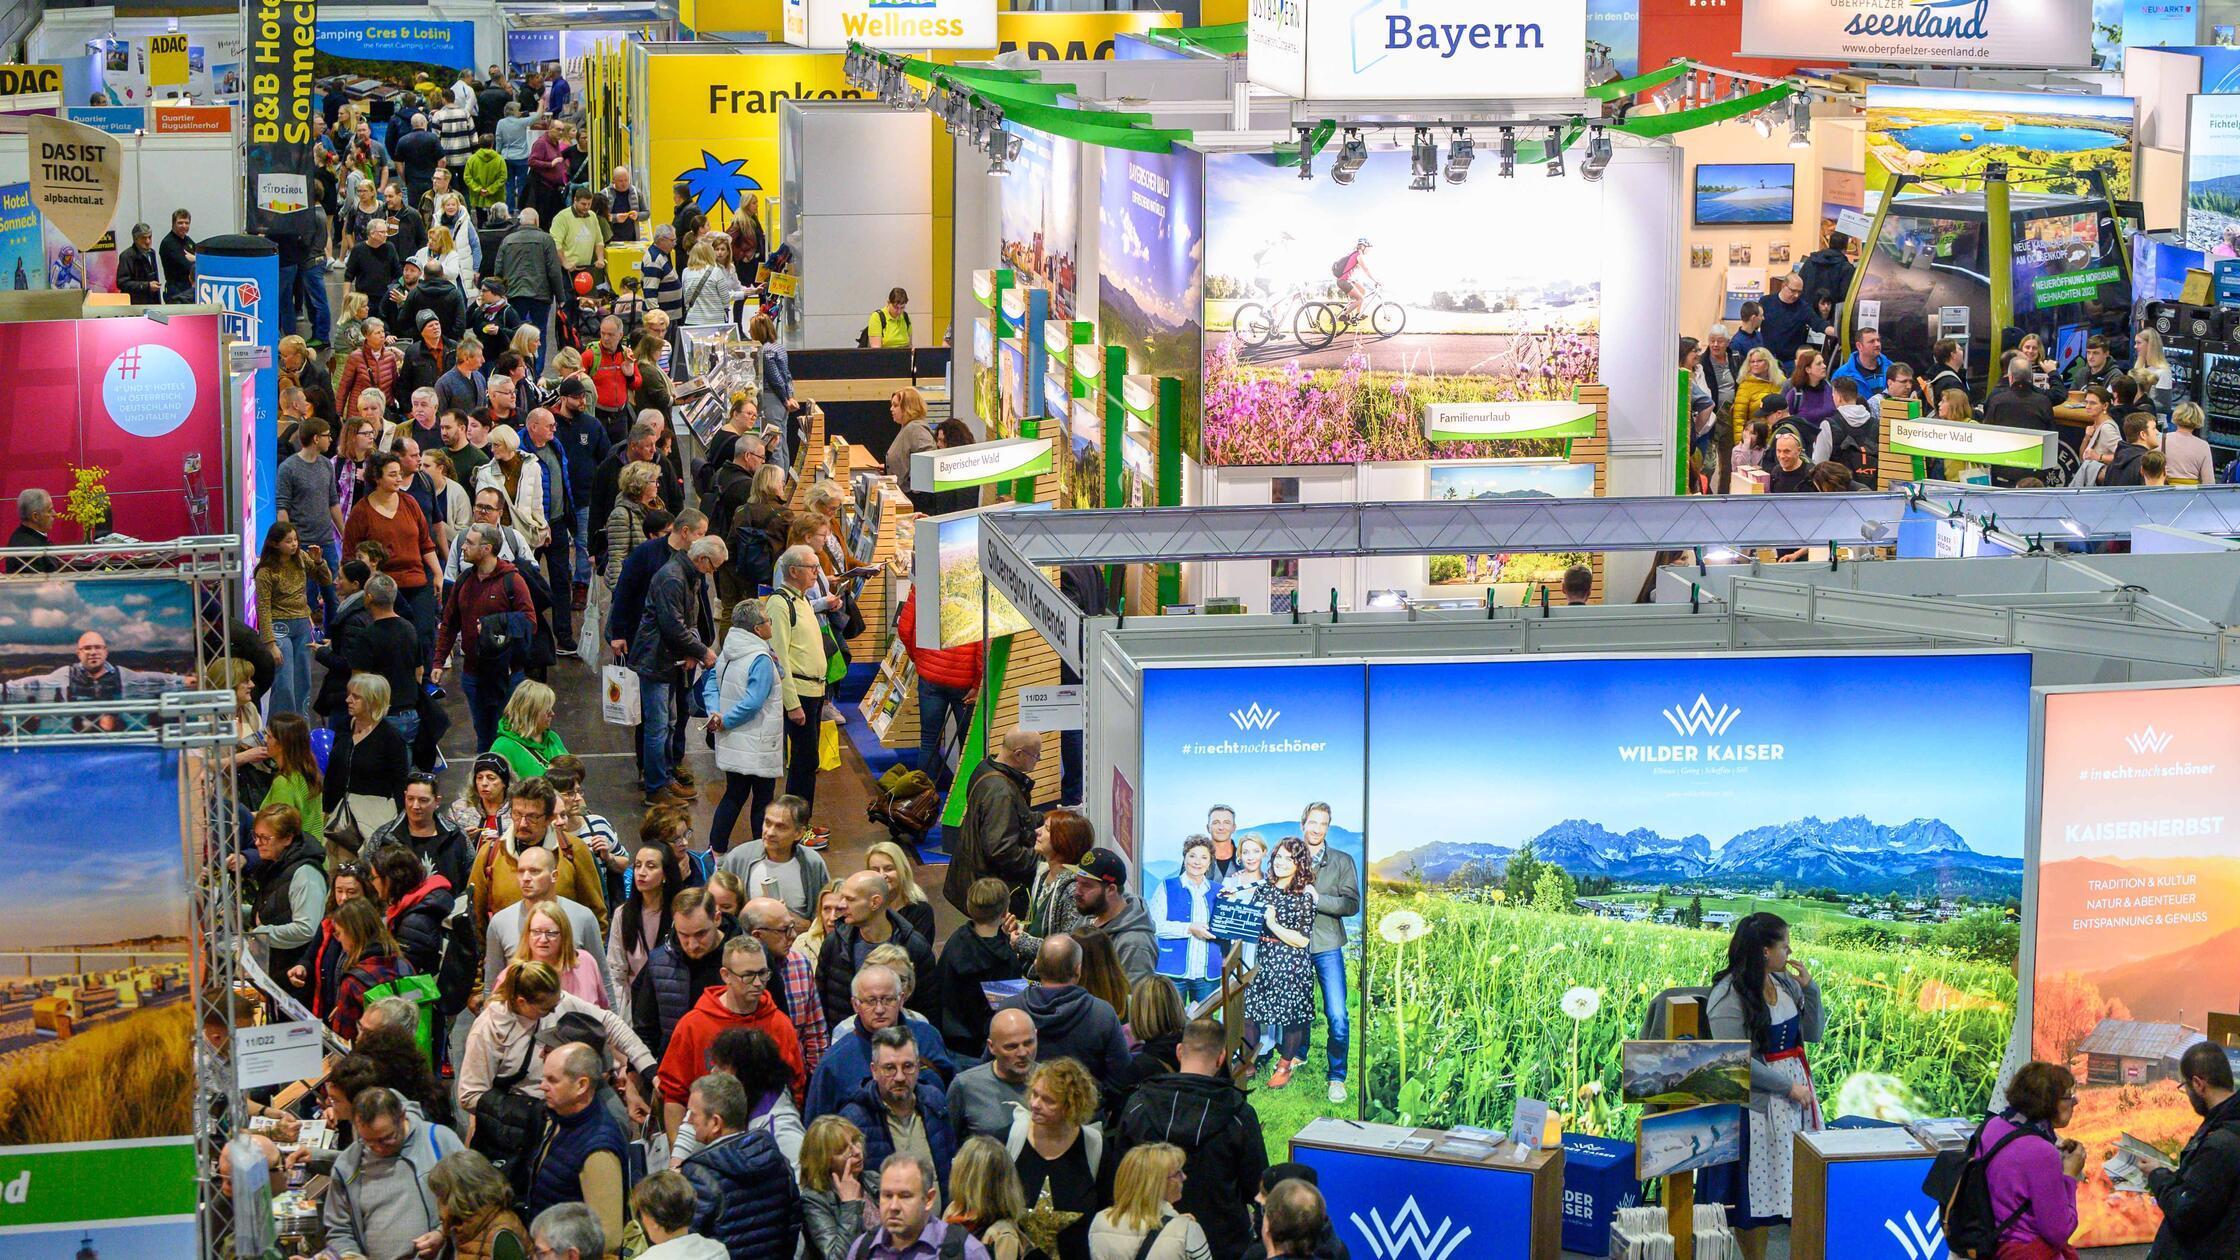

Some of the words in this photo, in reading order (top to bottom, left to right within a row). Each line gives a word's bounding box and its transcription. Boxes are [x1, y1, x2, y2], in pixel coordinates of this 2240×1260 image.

[842, 13, 964, 37] Wellness
[1605, 12, 1622, 21] den
[1844, 0, 1988, 39] seenland
[316, 29, 363, 42] Camping
[366, 27, 397, 38] Cres
[401, 27, 410, 38] &
[414, 27, 451, 42] Lošinj
[1385, 15, 1544, 58] Bayern
[152, 37, 187, 54] ADAC
[1842, 44, 1990, 58] www.oberpfaelzer-seenland.de
[284, 0, 315, 145] Sonnec
[254, 73, 279, 143] B&B
[162, 122, 220, 131] Augustinerhof
[42, 143, 77, 161] DAS
[80, 146, 106, 162] IST
[41, 164, 99, 184] TIROL.
[3, 191, 30, 210] Hotel
[43, 193, 104, 206] alpbachtal.at
[0, 210, 37, 232] Sonneck
[2013, 241, 2031, 253] NEUE
[2016, 255, 2026, 265] AM
[2035, 275, 2085, 290] NEUERÖFFNUNG
[2085, 270, 2119, 284] NORDBAHN
[200, 283, 235, 311] SKI
[2037, 289, 2081, 303] WEIHNACHTEN
[2082, 287, 2096, 298] 2023
[153, 382, 185, 391] HOTELS
[119, 402, 181, 412] DEUTSCHLAND
[146, 413, 177, 421] ITALIEN
[1440, 412, 1510, 423] Familienurlaub
[1897, 426, 1948, 441] Bayerischer
[1950, 431, 1973, 443] Wald
[940, 458, 980, 474] Bayerischer
[981, 452, 1000, 464] Wald
[987, 539, 1028, 606] Silberregion
[1028, 580, 1068, 648] Karwendel
[1025, 694, 1048, 702] 11/D23
[1618, 745, 1698, 762] WILDER
[1707, 743, 1785, 760] KAISER
[2065, 816, 2225, 843] KAISERHERBST
[2088, 878, 2145, 891] TRADITION
[2148, 878, 2155, 888] &
[2157, 874, 2197, 887] KULTUR
[2086, 897, 2122, 910] NATUR
[2124, 897, 2131, 908] &
[2134, 893, 2196, 907] ABENTEUER
[2073, 914, 2154, 930] ENTSPANNUNG
[2155, 914, 2162, 925] &
[2165, 911, 2208, 925] GENUSS
[245, 1036, 275, 1047] 11/D22
